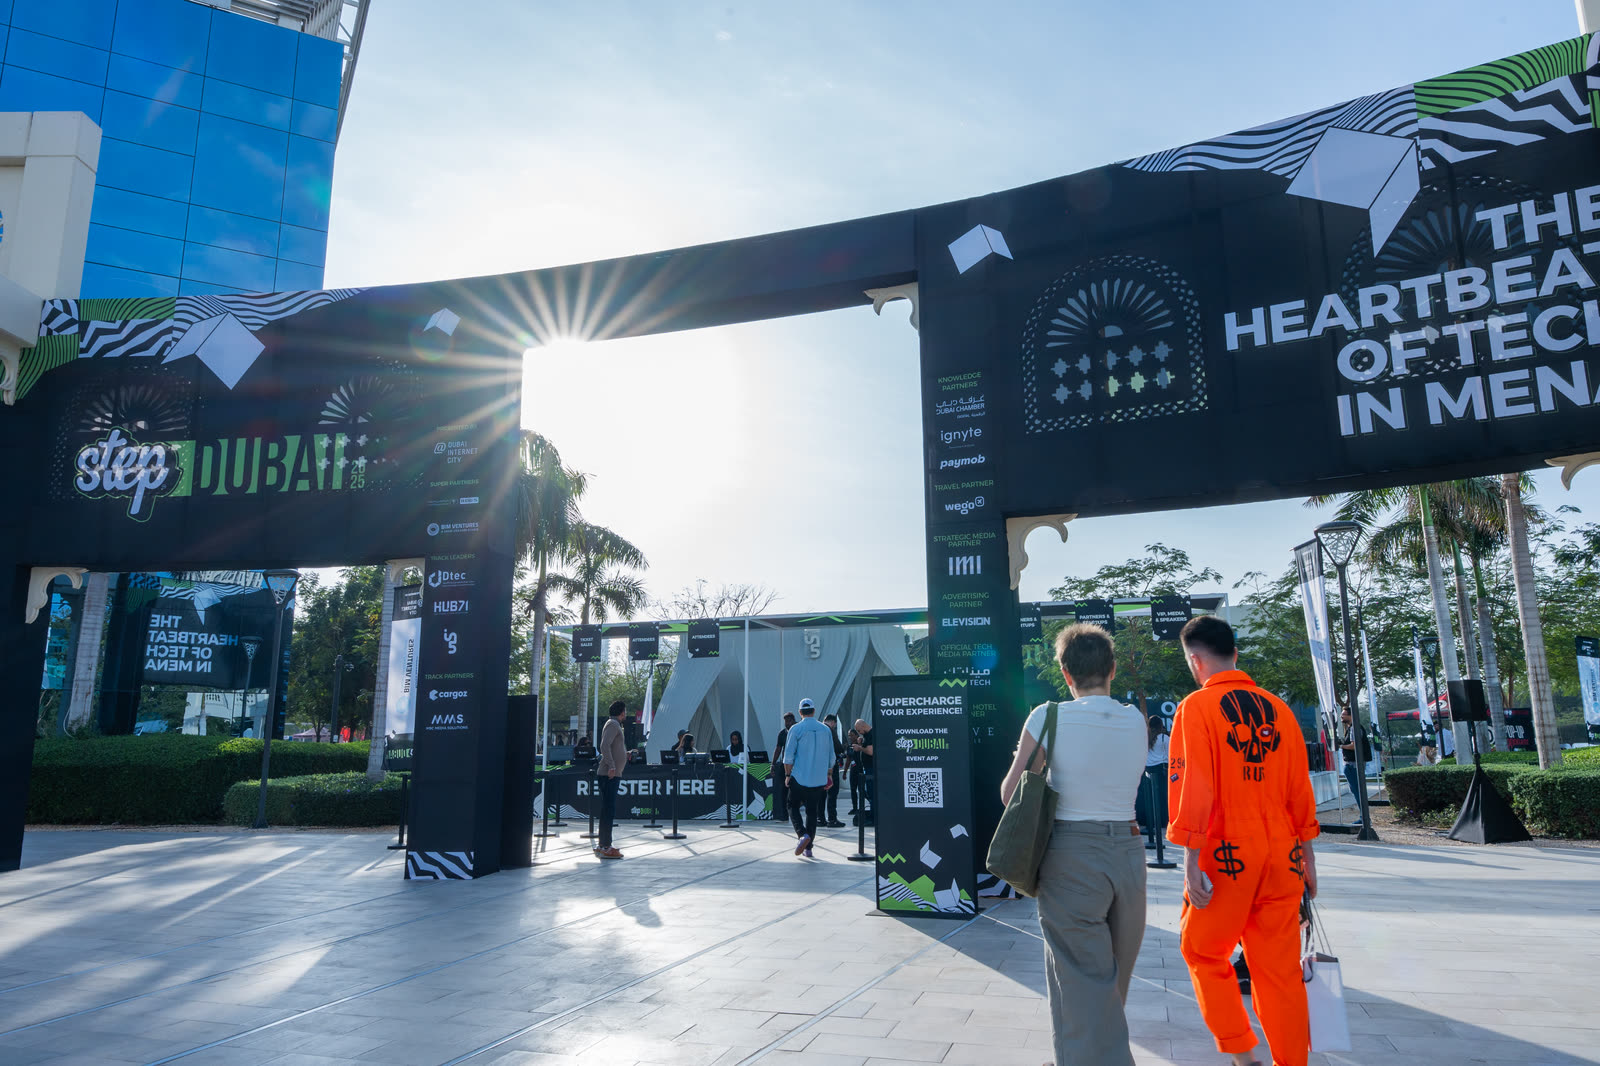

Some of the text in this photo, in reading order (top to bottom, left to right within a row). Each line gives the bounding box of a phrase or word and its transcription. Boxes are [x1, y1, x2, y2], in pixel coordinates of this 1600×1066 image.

[1476, 184, 1600, 250] THE
[1337, 329, 1428, 382] OF
[937, 371, 982, 384] KNOWLEDGE
[942, 381, 978, 391] PARTNERS
[1337, 359, 1600, 437] IN MEN
[956, 403, 985, 412] CHAMBER
[940, 427, 982, 444] ignyte
[447, 447, 479, 456] INTERNET
[447, 456, 462, 464] CITY
[940, 454, 986, 470] paymob
[76, 429, 347, 515] step DUBAI
[350, 474, 365, 489] 25
[935, 480, 994, 491] TRAVEL PARTNER
[945, 501, 975, 515] wego
[933, 533, 971, 542] STRATEGIC
[948, 539, 982, 547] PARTNER
[442, 571, 467, 581] Dtec
[942, 592, 990, 600] ADVERTISING
[942, 616, 991, 627] ELEVISION
[438, 691, 468, 700] cargoz
[880, 696, 962, 707] SUPERCHARGE
[880, 708, 904, 716] YOUR
[906, 707, 963, 716] EXPERIENCE!
[896, 736, 914, 753] step
[666, 779, 715, 796] HERE
